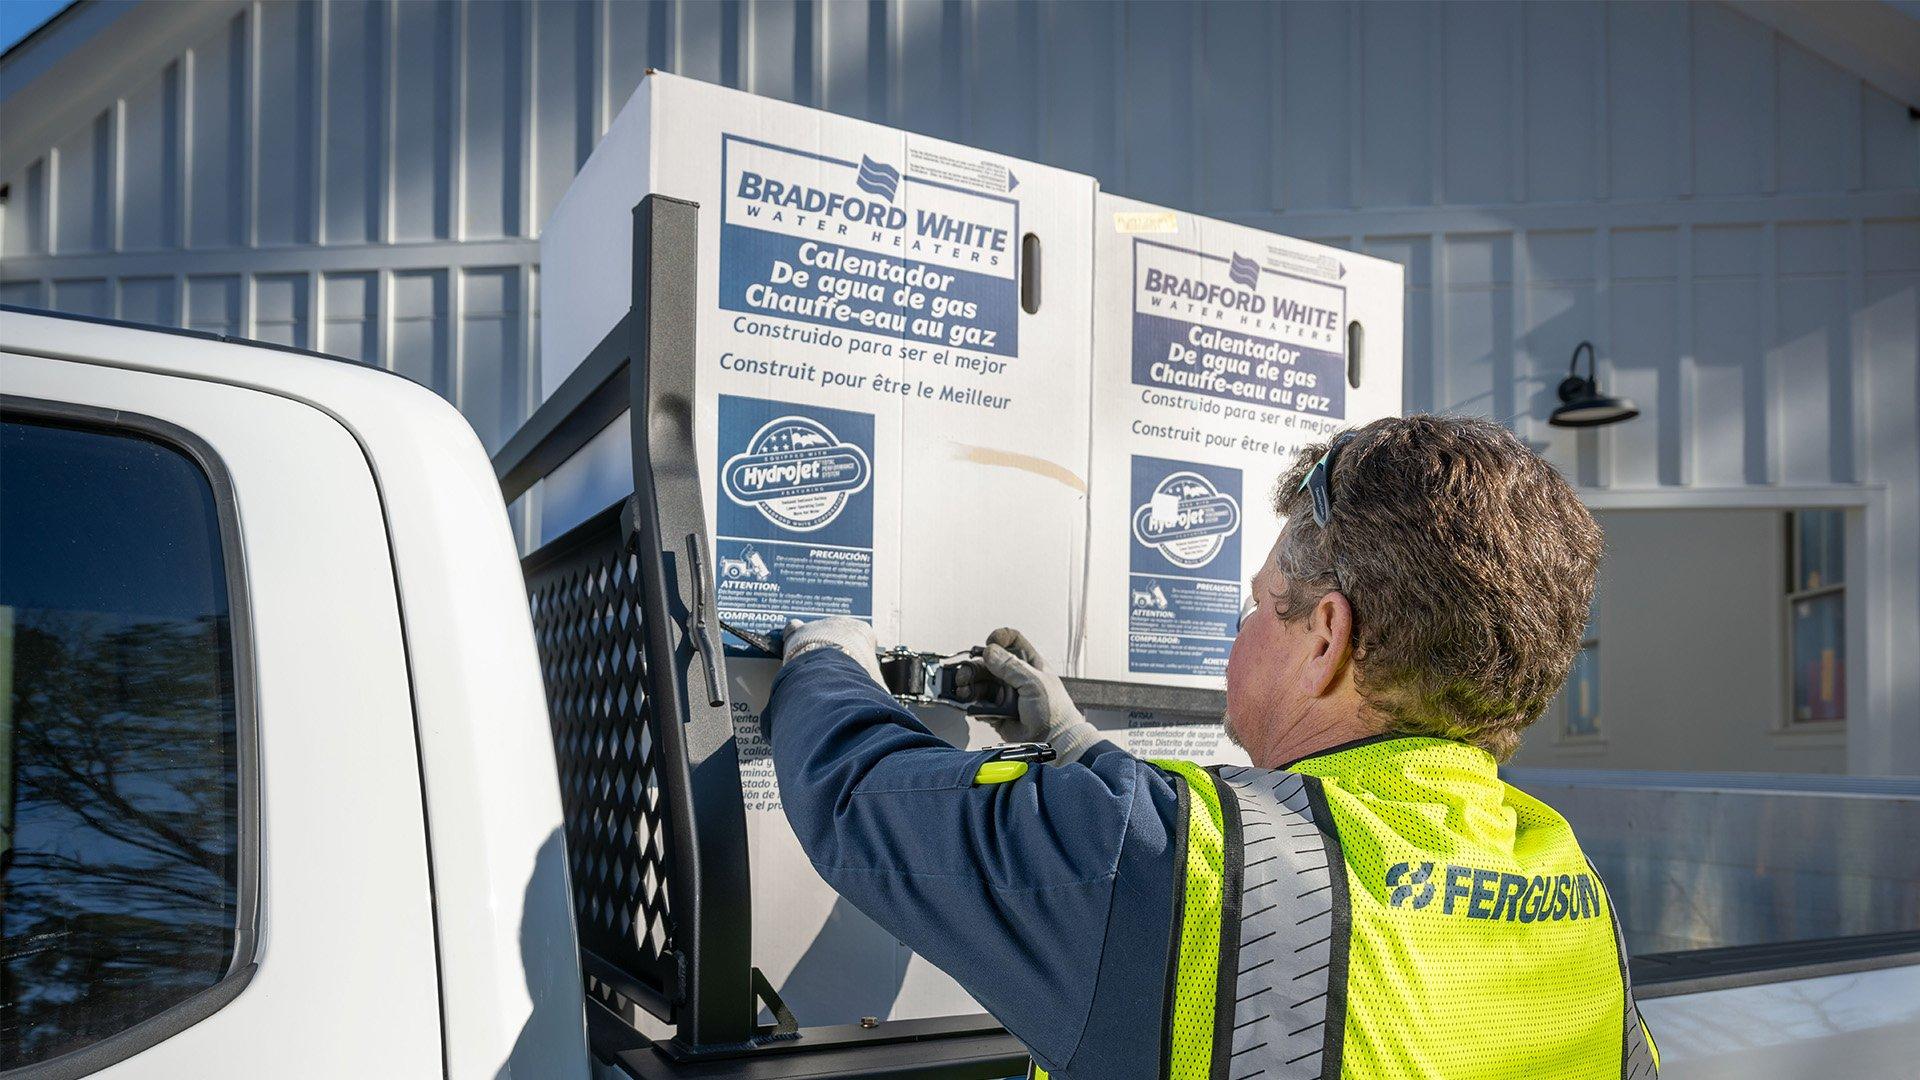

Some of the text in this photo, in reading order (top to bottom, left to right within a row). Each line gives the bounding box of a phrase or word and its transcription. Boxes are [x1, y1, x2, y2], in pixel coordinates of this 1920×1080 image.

[737, 171, 1009, 253] BRADFORD WHITE
[747, 205, 999, 266] WATER HEATERS
[770, 261, 978, 319] De agua de gas
[798, 243, 955, 292] Calentador
[745, 283, 998, 348] Chauffe-eau au gaz
[1145, 267, 1338, 331] BRADFORD WHITE
[1151, 296, 1333, 343] WATER HEATERS
[733, 316, 1007, 377] Construido para ser el mejor
[1168, 342, 1317, 390] De agua de gas
[1188, 325, 1300, 365] Calentador
[720, 352, 1012, 411] Construit pour être le Meilleur
[1150, 361, 1331, 412] Chauffe-eau au gaz
[1141, 389, 1336, 436] Construido para ser el mejor
[1132, 419, 1202, 443] Construit
[1205, 432, 1238, 448] pour
[1241, 435, 1270, 455] être
[1273, 441, 1286, 457] le
[744, 461, 820, 489] Hydrojet
[810, 550, 871, 562] PRECAUCIÓN:
[720, 580, 780, 592] ATTENTION:
[718, 611, 787, 623] COMPRADOR:
[742, 779, 771, 789] stado
[1443, 864, 1601, 924] FERGUSON
